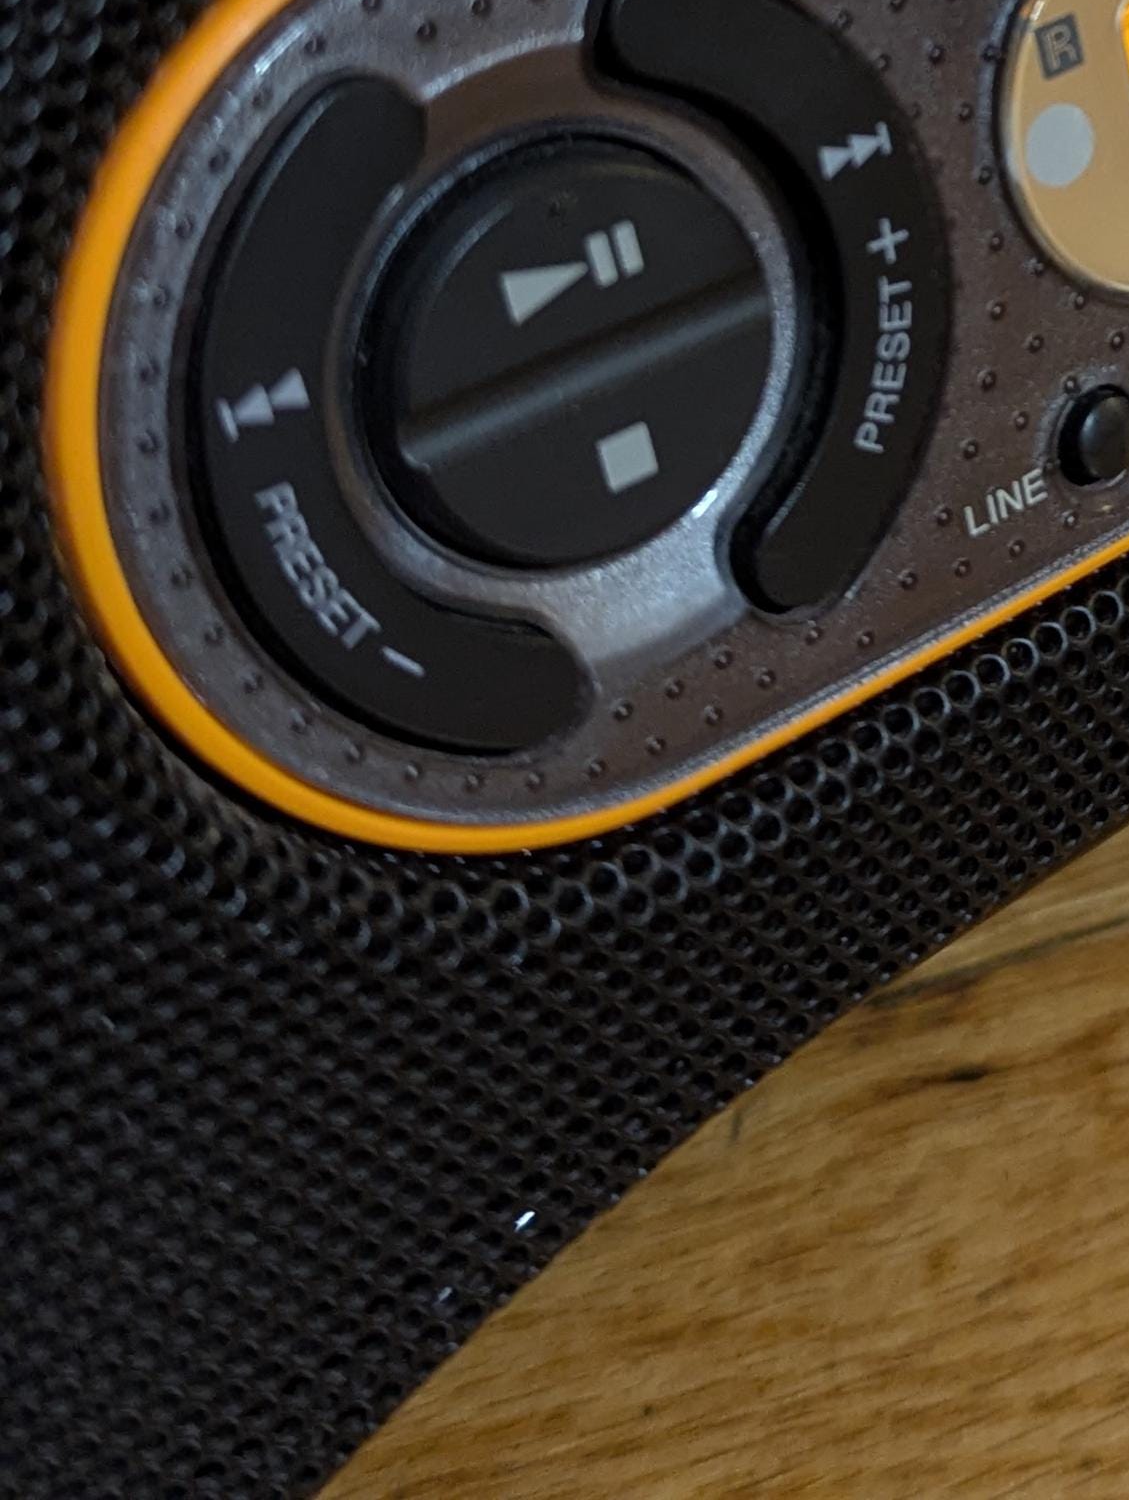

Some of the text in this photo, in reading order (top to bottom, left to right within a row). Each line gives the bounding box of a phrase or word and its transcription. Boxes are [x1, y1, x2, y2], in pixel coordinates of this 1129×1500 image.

[854, 275, 912, 454] PRESET
[254, 481, 381, 649] PRESET
[964, 467, 1049, 538] LINE
